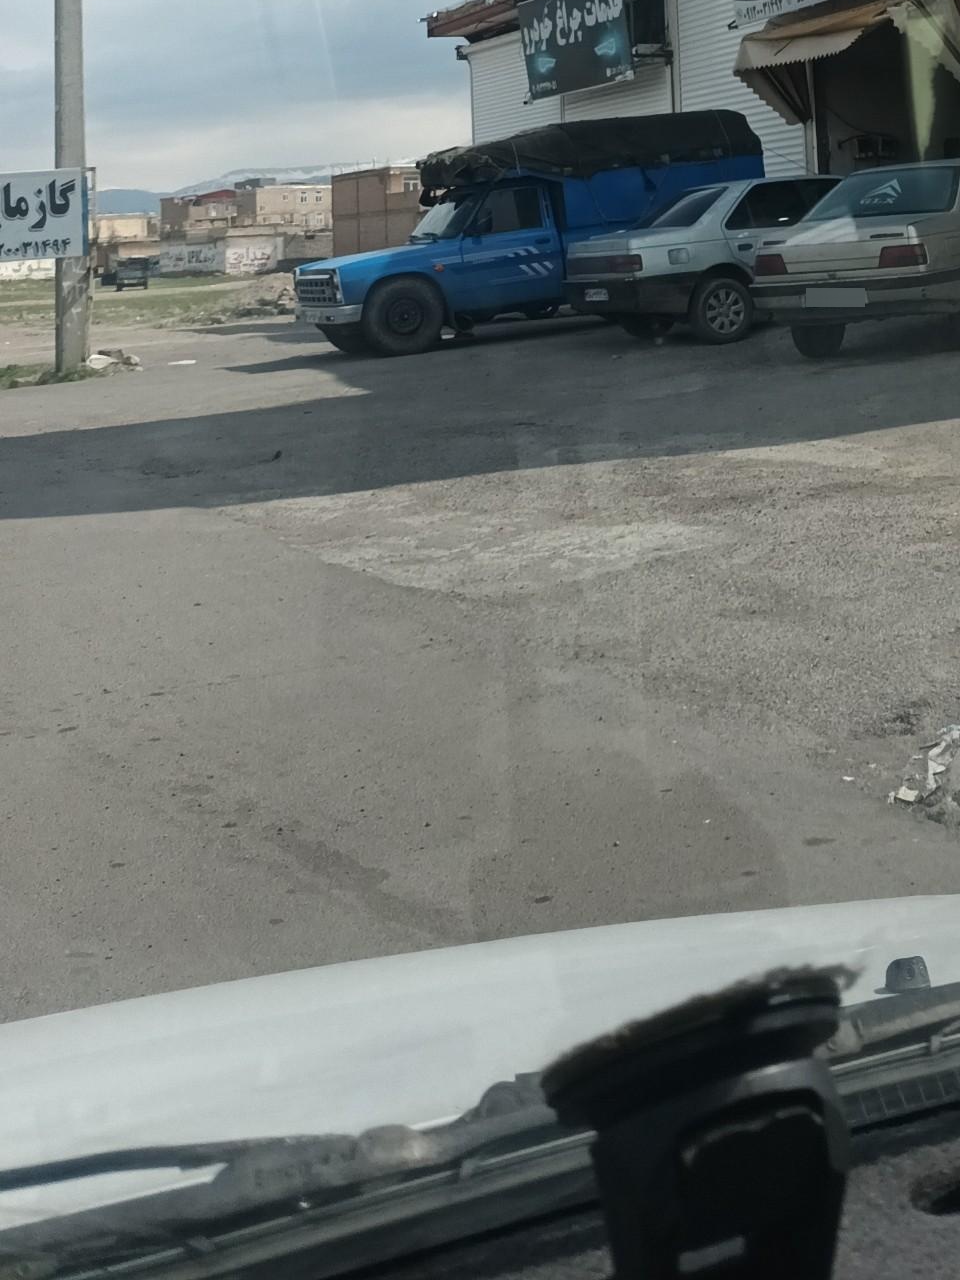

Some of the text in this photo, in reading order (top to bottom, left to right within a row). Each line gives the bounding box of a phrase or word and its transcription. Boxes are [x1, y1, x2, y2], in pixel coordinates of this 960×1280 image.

[555, 0, 583, 46] چراغ
[0, 178, 76, 230] گاز ما
[0, 237, 71, 257] ۲۰۰۳۱۴۹۴
